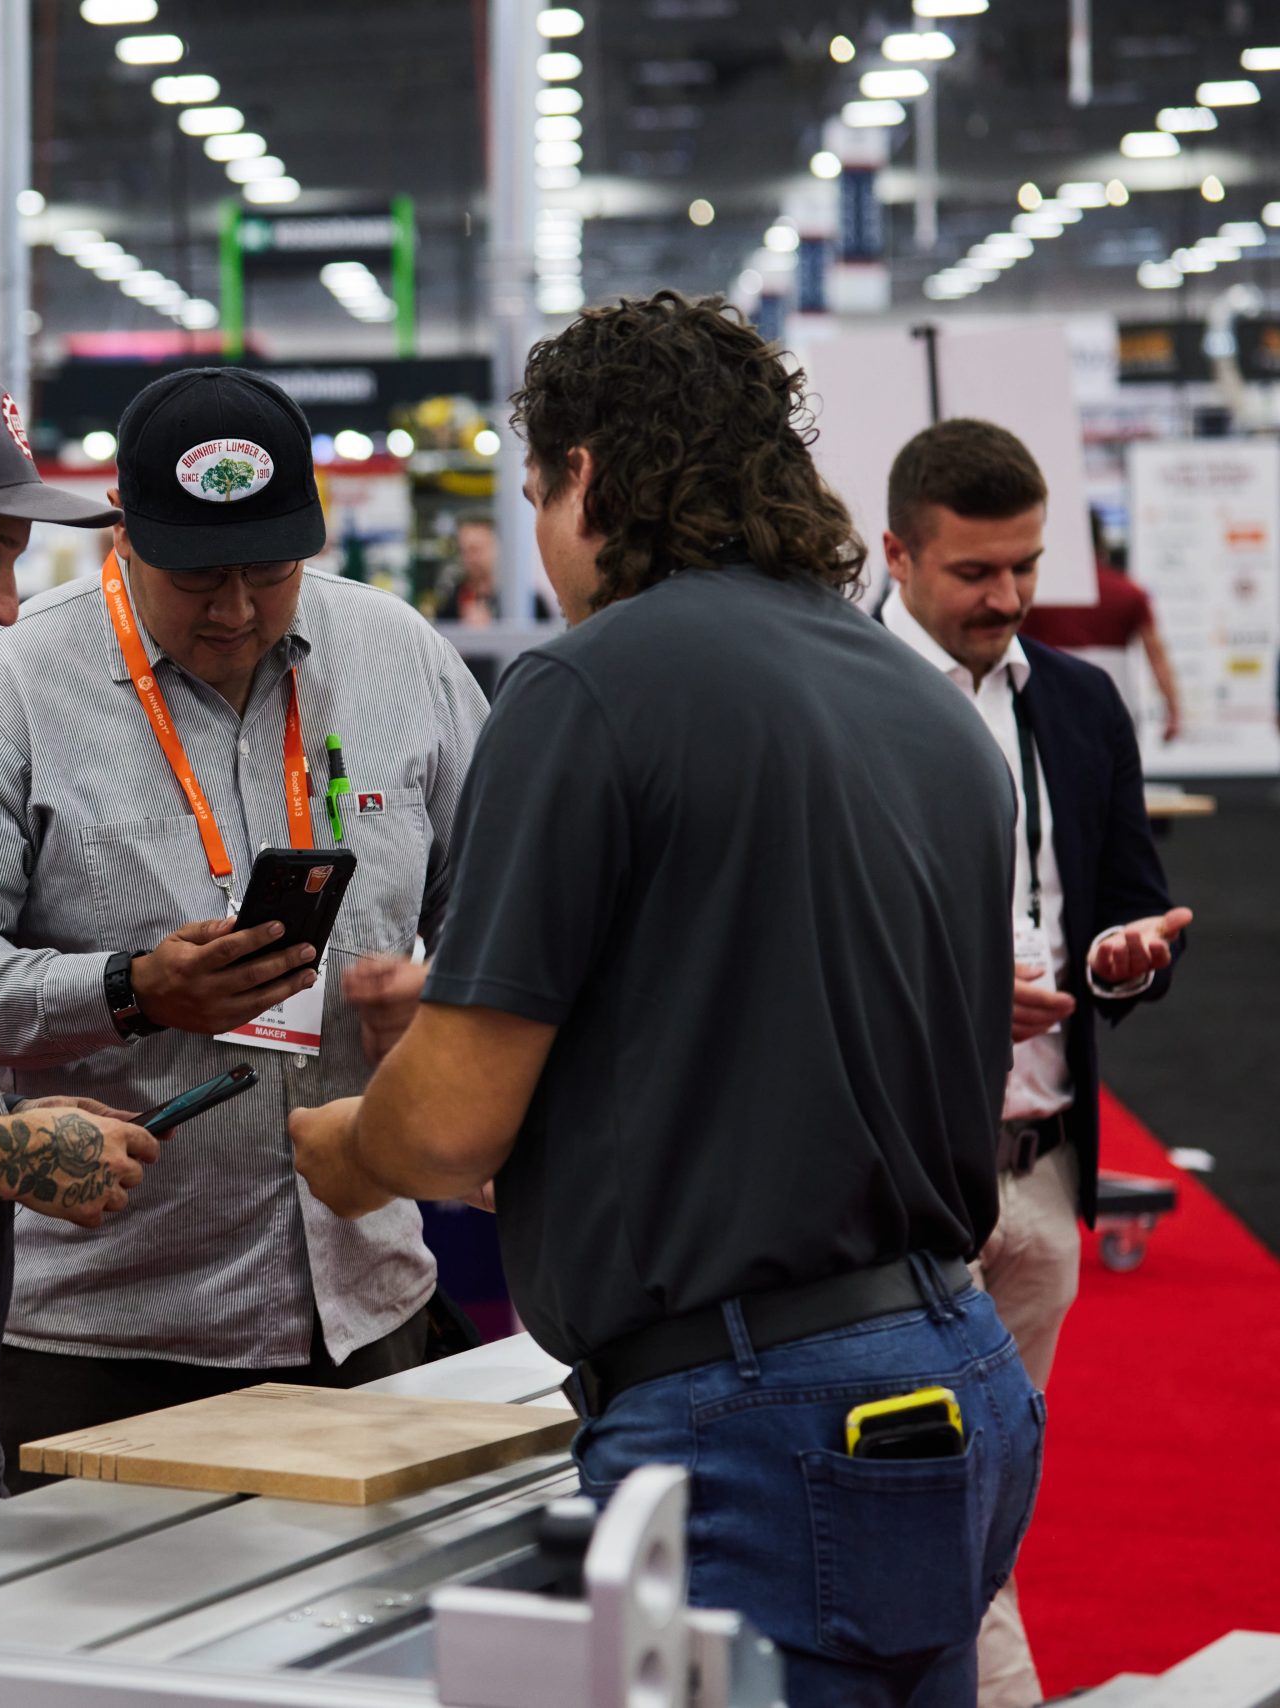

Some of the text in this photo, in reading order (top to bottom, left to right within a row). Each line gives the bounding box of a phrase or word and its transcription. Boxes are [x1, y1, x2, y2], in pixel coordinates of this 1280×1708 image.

[181, 442, 222, 468] BOHNHOFF
[226, 439, 260, 458] LUMBER
[181, 468, 270, 482] SINCE 1910
[184, 777, 208, 820] Booth 3413
[291, 770, 303, 817] Booth 3413
[255, 1026, 288, 1040] MAKER
